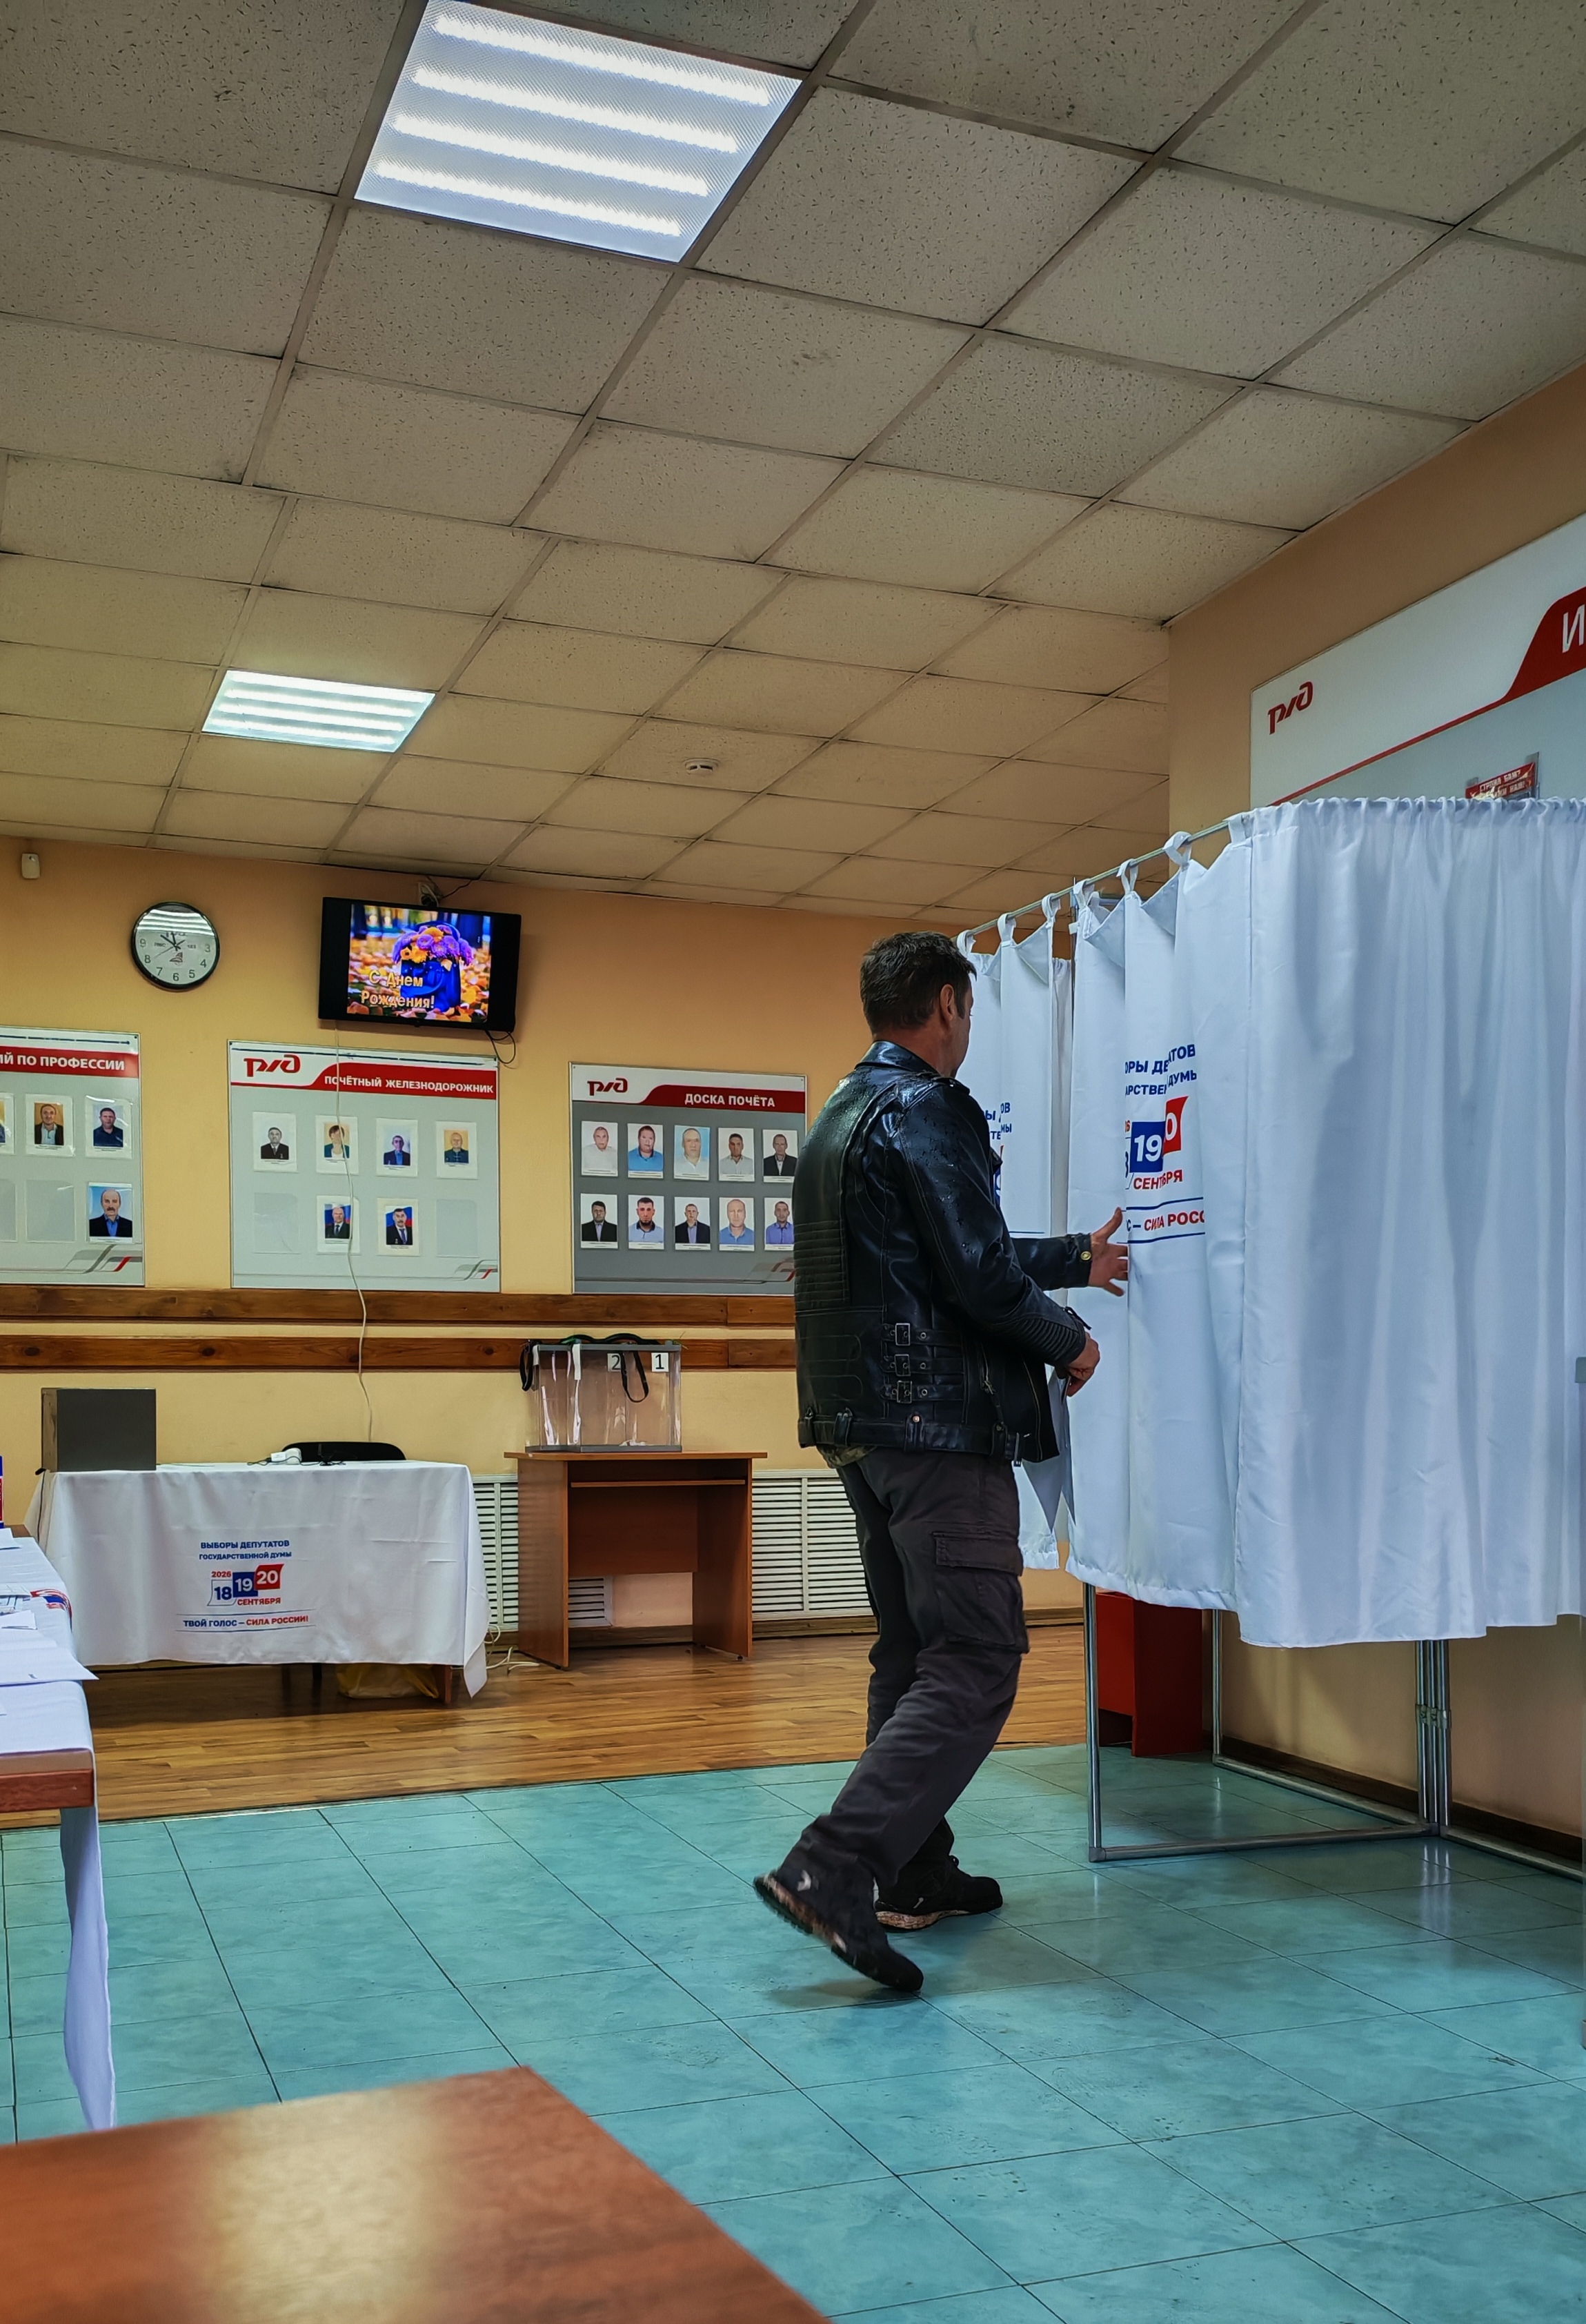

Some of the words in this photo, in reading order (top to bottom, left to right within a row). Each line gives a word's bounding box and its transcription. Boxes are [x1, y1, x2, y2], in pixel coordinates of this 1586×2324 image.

[139, 938, 146, 947] 9
[205, 944, 210, 952] 3
[144, 955, 151, 963] 8
[200, 959, 207, 967] 4
[156, 967, 163, 976] 7
[172, 973, 179, 981] 6
[188, 969, 195, 978] 5
[369, 969, 381, 984] С
[386, 972, 424, 987] Днем
[361, 991, 435, 1009] Рождения!
[17, 1055, 37, 1065] ПО
[40, 1056, 125, 1070] ПРОФЕССИИ
[324, 1076, 382, 1087] ПОЧЁТНЫЙ
[386, 1079, 493, 1094] ЖЕЛЕЗНОДОРОЖНИК
[684, 1093, 725, 1105] ДОСКА
[728, 1094, 775, 1107] ПОЧЁТА
[1134, 1134, 1162, 1162] 19
[611, 1355, 621, 1370] 2
[655, 1354, 664, 1369] 1
[240, 1540, 290, 1549] ДЕПУТАТОВ
[257, 1570, 278, 1585] 20
[235, 1578, 253, 1592] 19
[214, 1586, 232, 1600] 18
[237, 1597, 281, 1606] СЕНТЯБРЯ
[183, 1619, 206, 1627] ТВОЙ
[271, 1615, 308, 1624] РОССИИ!
